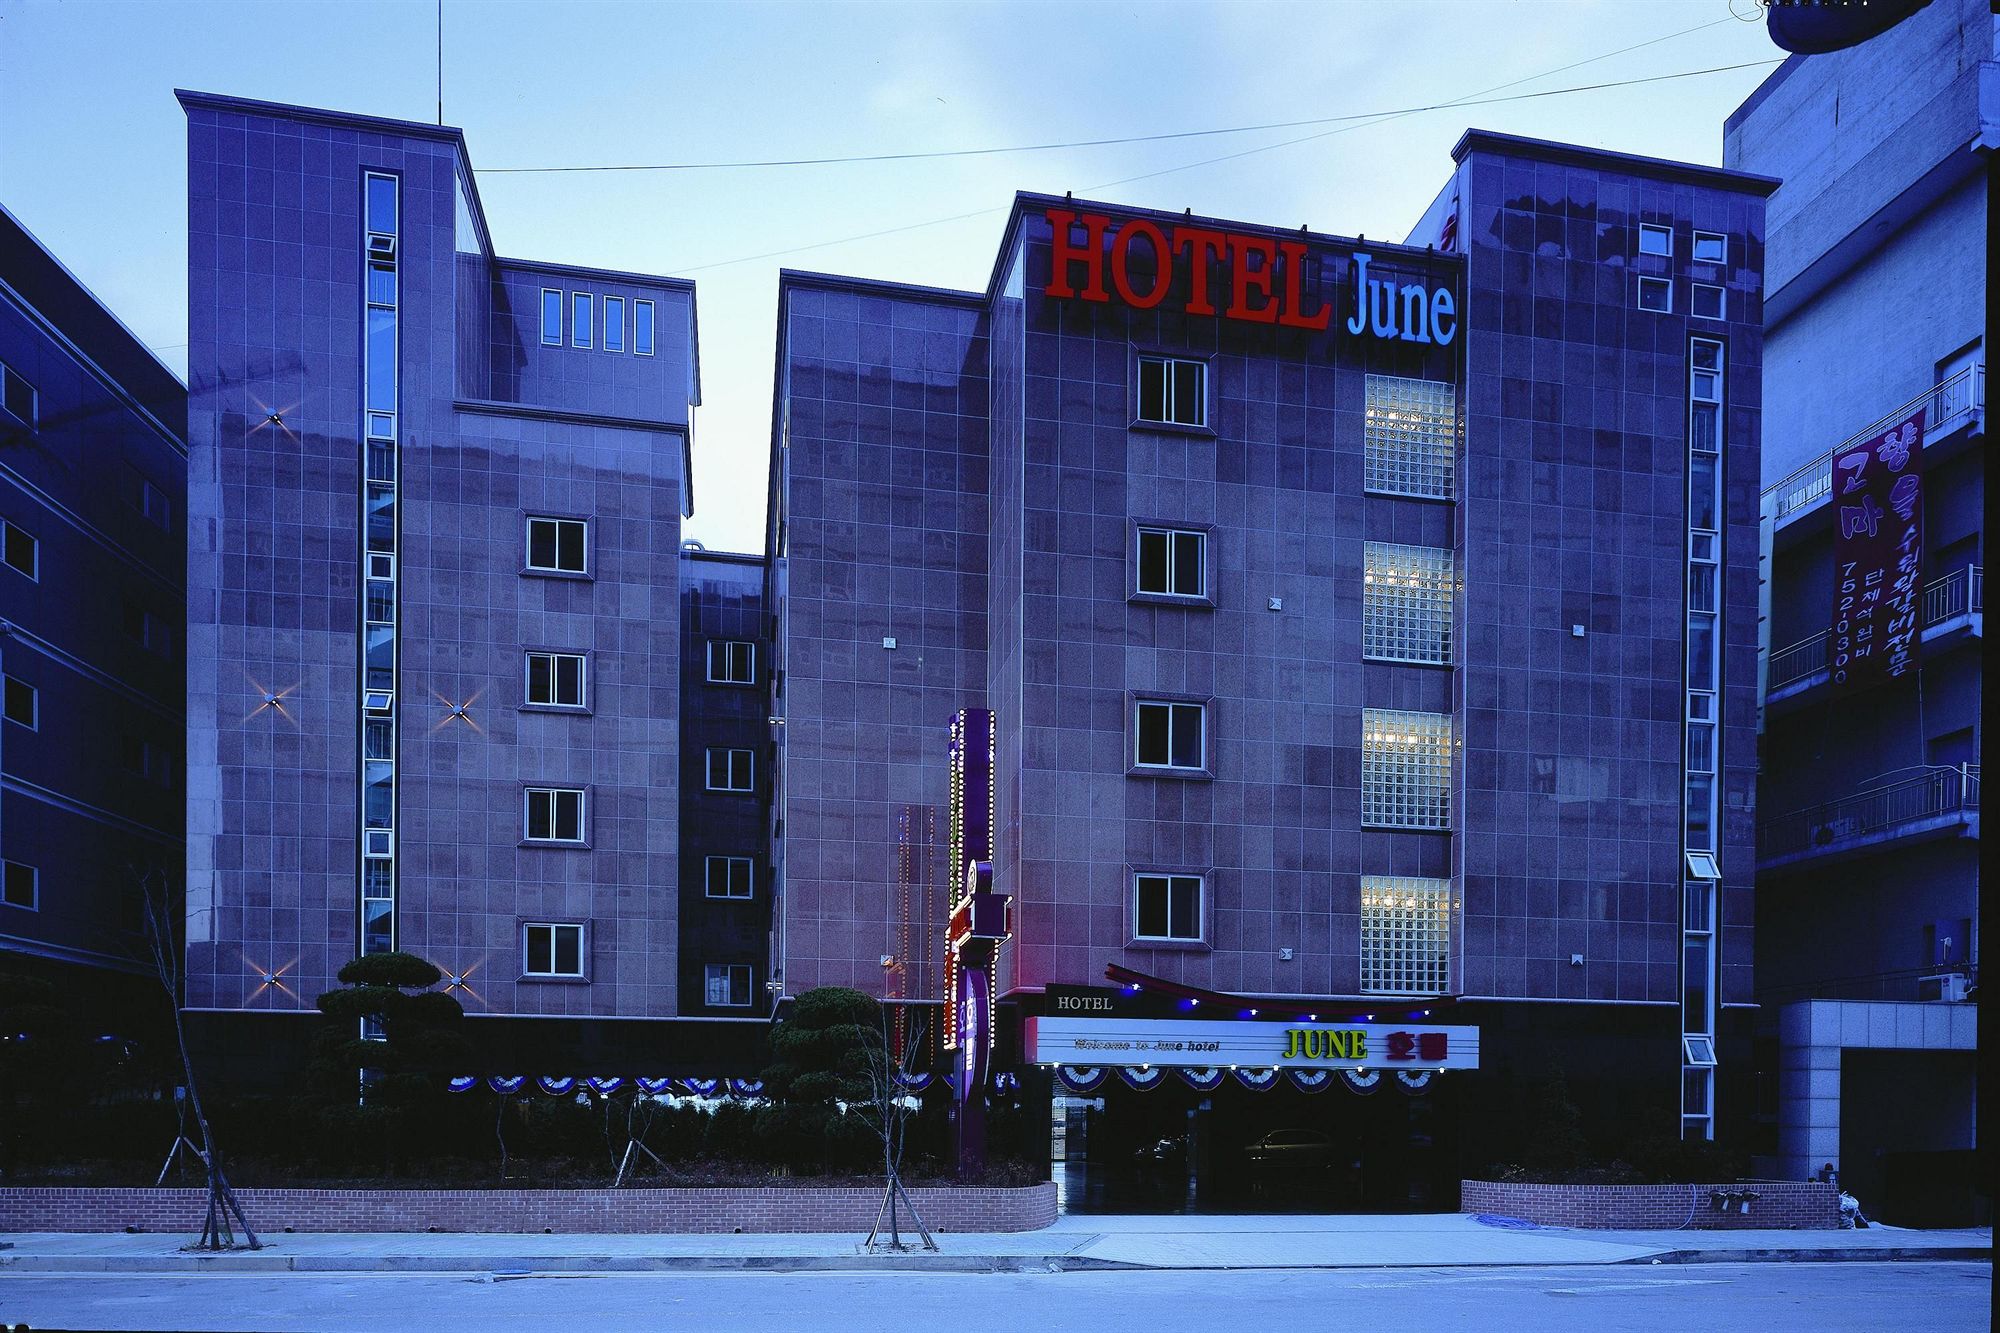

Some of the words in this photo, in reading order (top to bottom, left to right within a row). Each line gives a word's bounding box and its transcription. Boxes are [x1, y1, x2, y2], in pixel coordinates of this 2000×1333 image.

[1045, 209, 1332, 330] HOTEL
[1347, 252, 1457, 346] June
[1834, 561, 1857, 684] 752-0300
[1057, 996, 1113, 1010] HOTEL
[1153, 1040, 1183, 1051] June
[1187, 1041, 1220, 1052] hotel
[1283, 1029, 1368, 1059] JUNE
